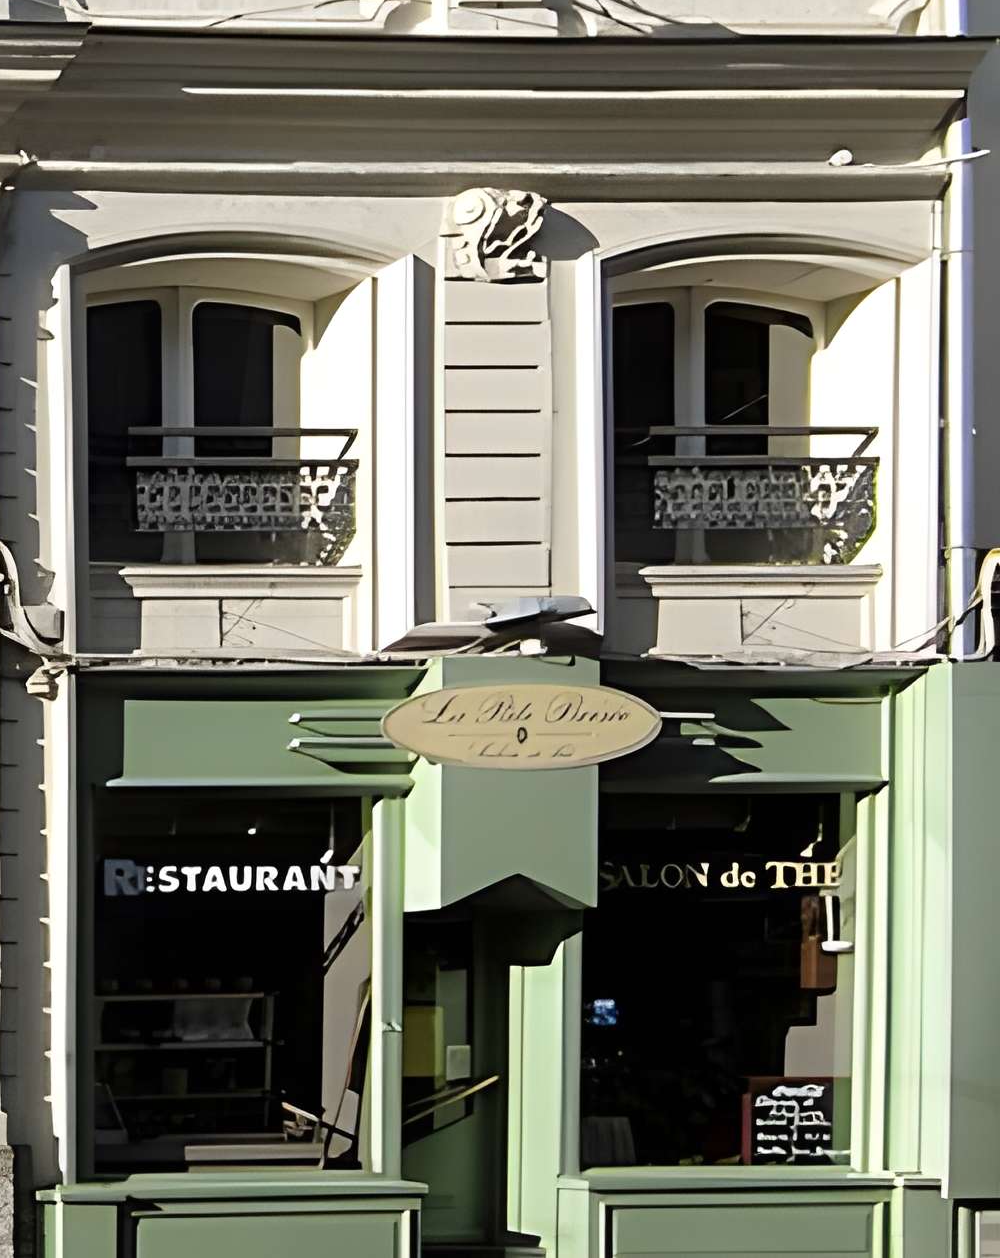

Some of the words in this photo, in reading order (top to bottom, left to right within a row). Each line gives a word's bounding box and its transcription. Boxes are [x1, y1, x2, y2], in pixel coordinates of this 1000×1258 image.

[104, 858, 360, 896] RESTAURANT
[600, 861, 710, 890] SALON
[720, 862, 757, 888] de
